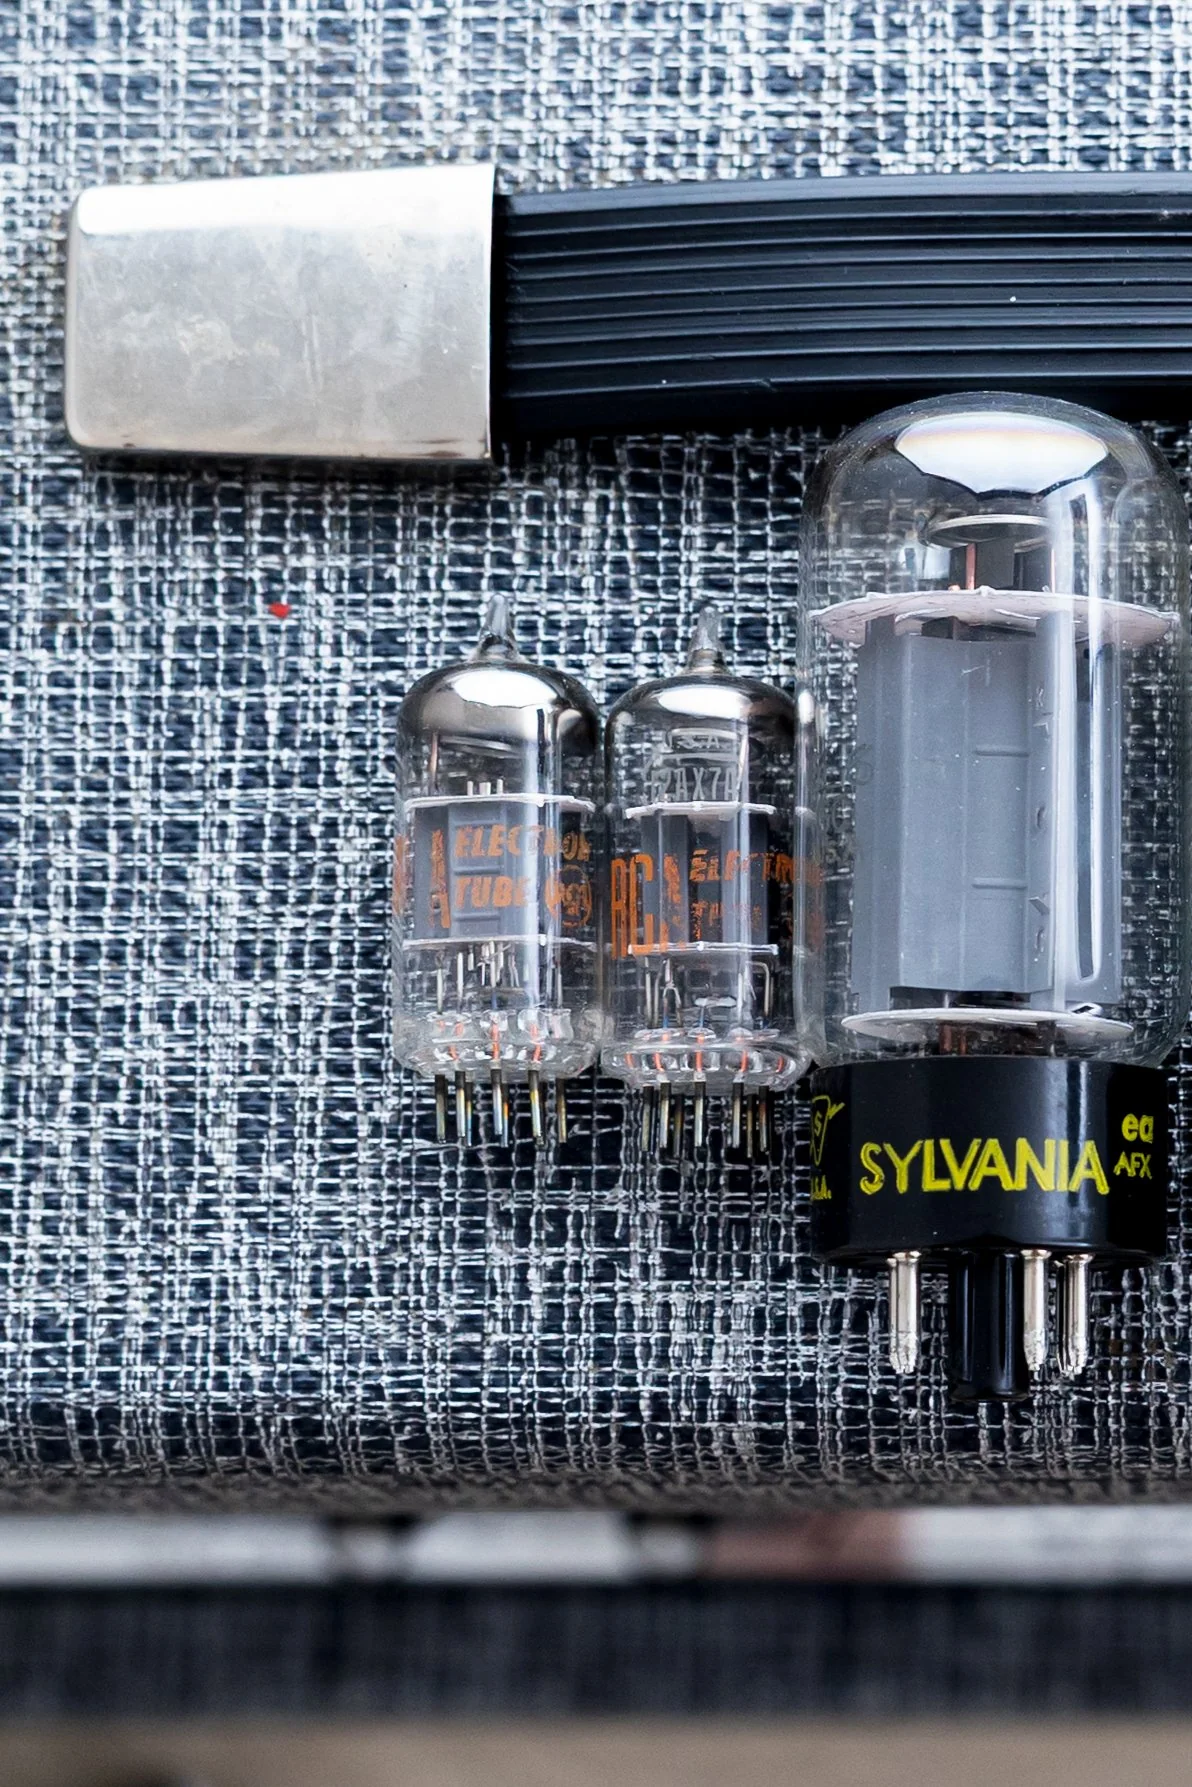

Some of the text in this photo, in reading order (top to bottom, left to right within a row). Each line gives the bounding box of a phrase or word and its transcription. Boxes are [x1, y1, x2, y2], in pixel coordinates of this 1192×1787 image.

[454, 875, 531, 909] TUBE
[859, 1137, 1110, 1195] SYLVANIA
[1113, 1151, 1153, 1179] AFX
